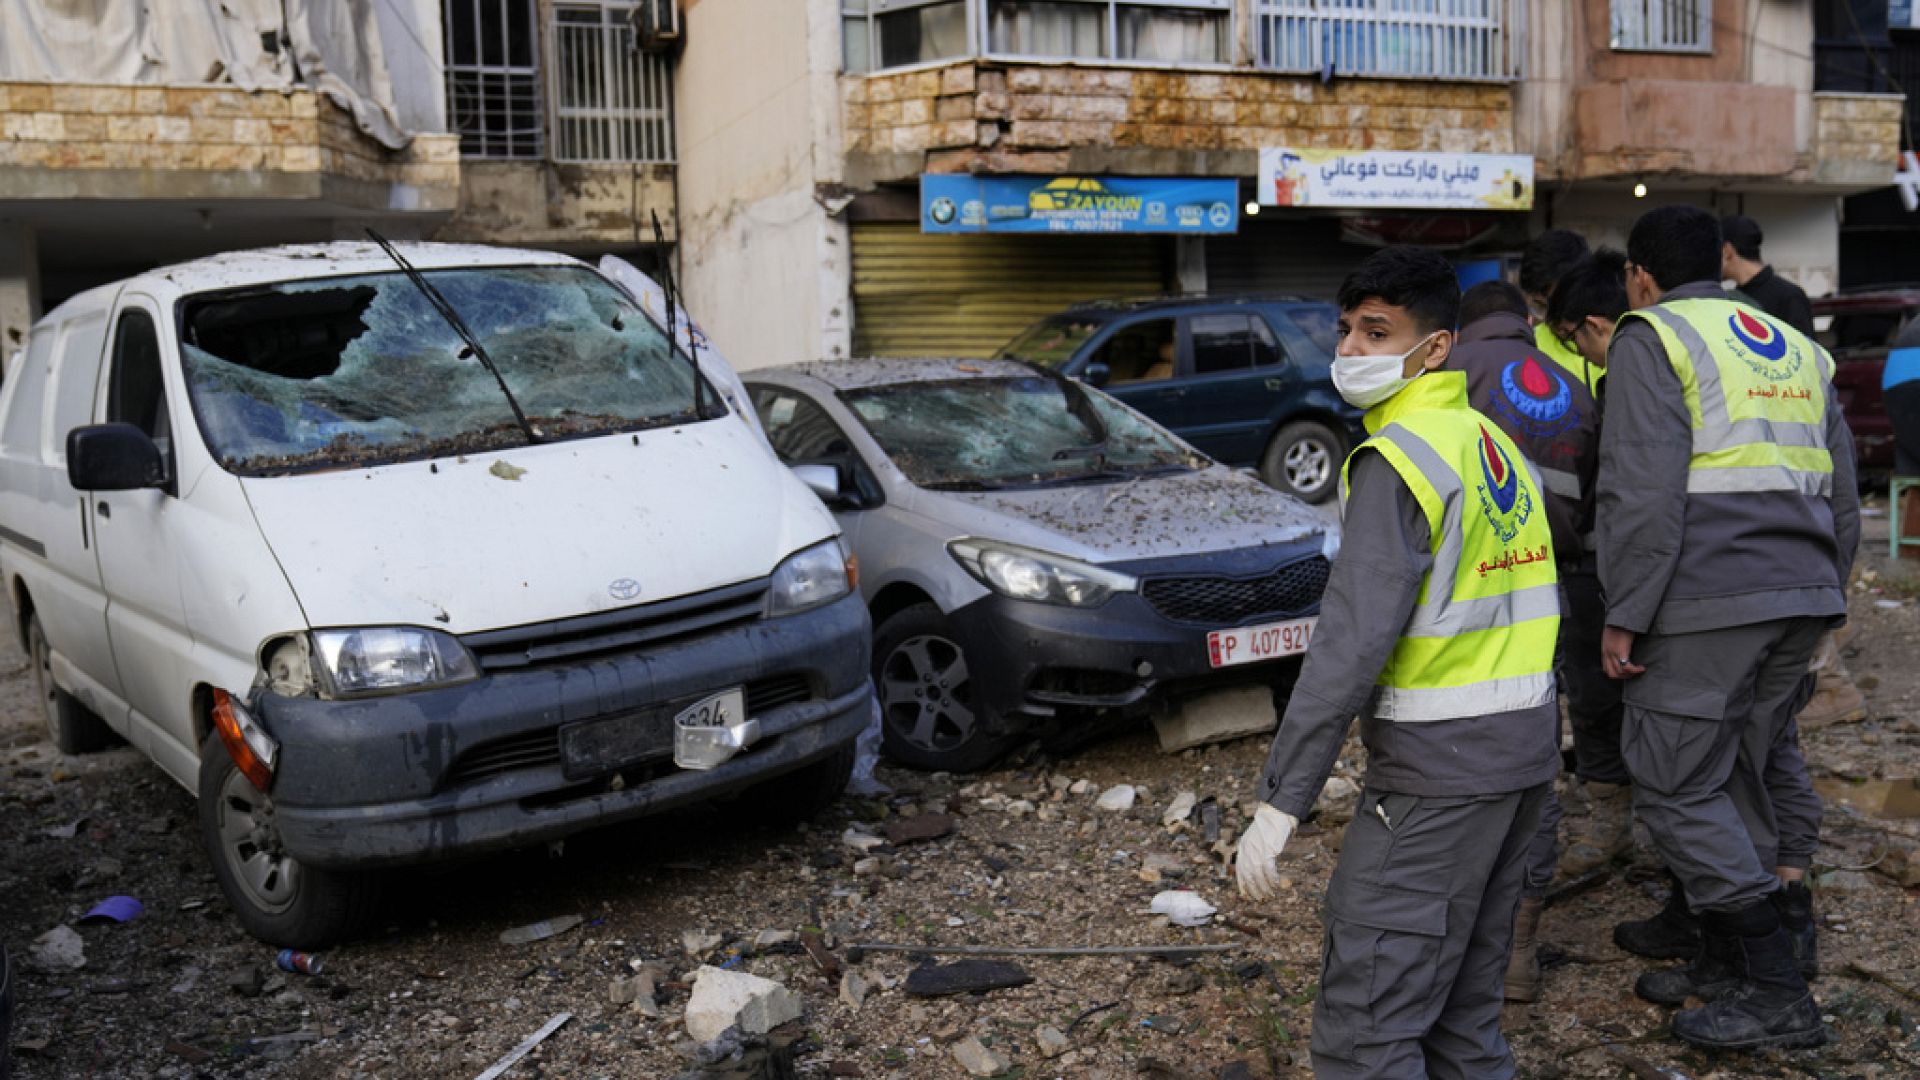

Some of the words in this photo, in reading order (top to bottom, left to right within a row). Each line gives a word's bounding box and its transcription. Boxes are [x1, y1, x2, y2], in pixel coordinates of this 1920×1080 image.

[1382, 158, 1439, 182] ماركت
[1442, 159, 1480, 186] ميني
[1100, 211, 1138, 221] SERVICE
[1225, 636, 1237, 660] P
[1250, 623, 1312, 656] 407921
